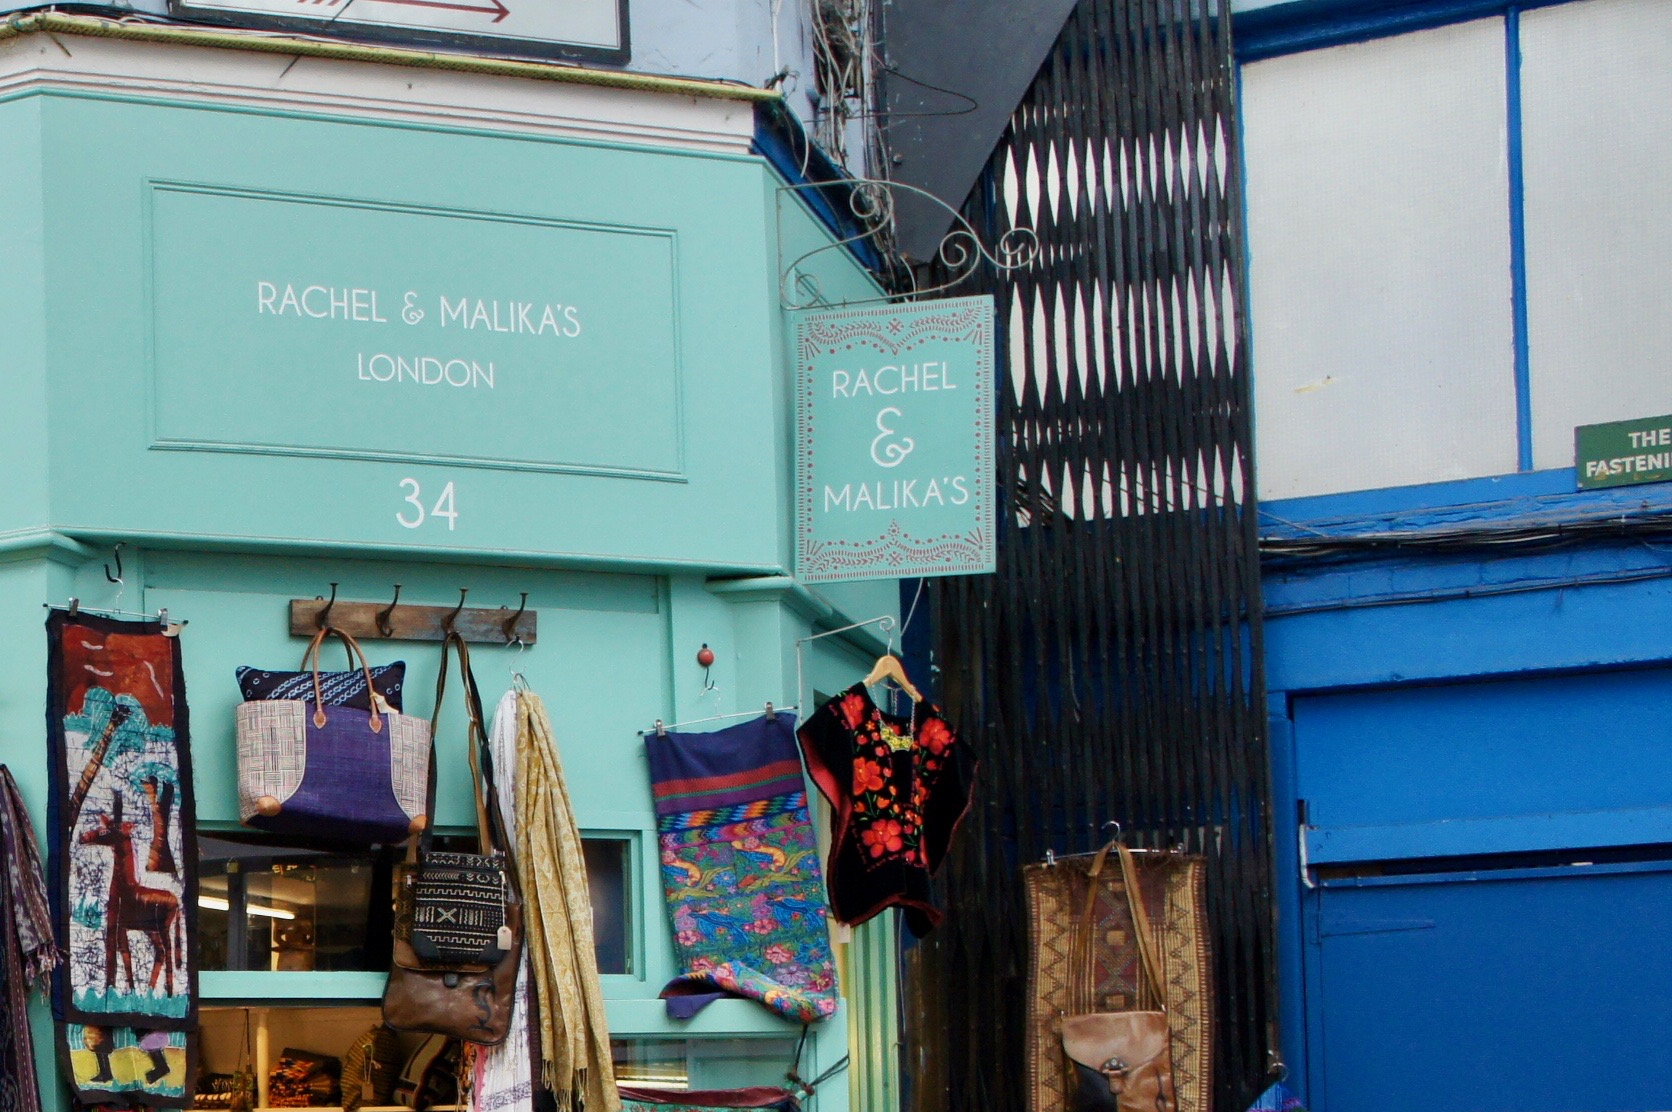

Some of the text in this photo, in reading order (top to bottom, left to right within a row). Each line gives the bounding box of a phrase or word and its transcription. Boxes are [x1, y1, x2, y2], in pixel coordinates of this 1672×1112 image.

[258, 281, 580, 337] RACHEL & MALIKA'S
[358, 353, 494, 389] LONDON
[832, 362, 957, 398] RACHEL
[870, 407, 914, 468] &
[1628, 428, 1671, 448] THE
[1586, 452, 1672, 478] FASTENI
[396, 477, 458, 531] 34
[824, 476, 969, 513] MALIKA'S
